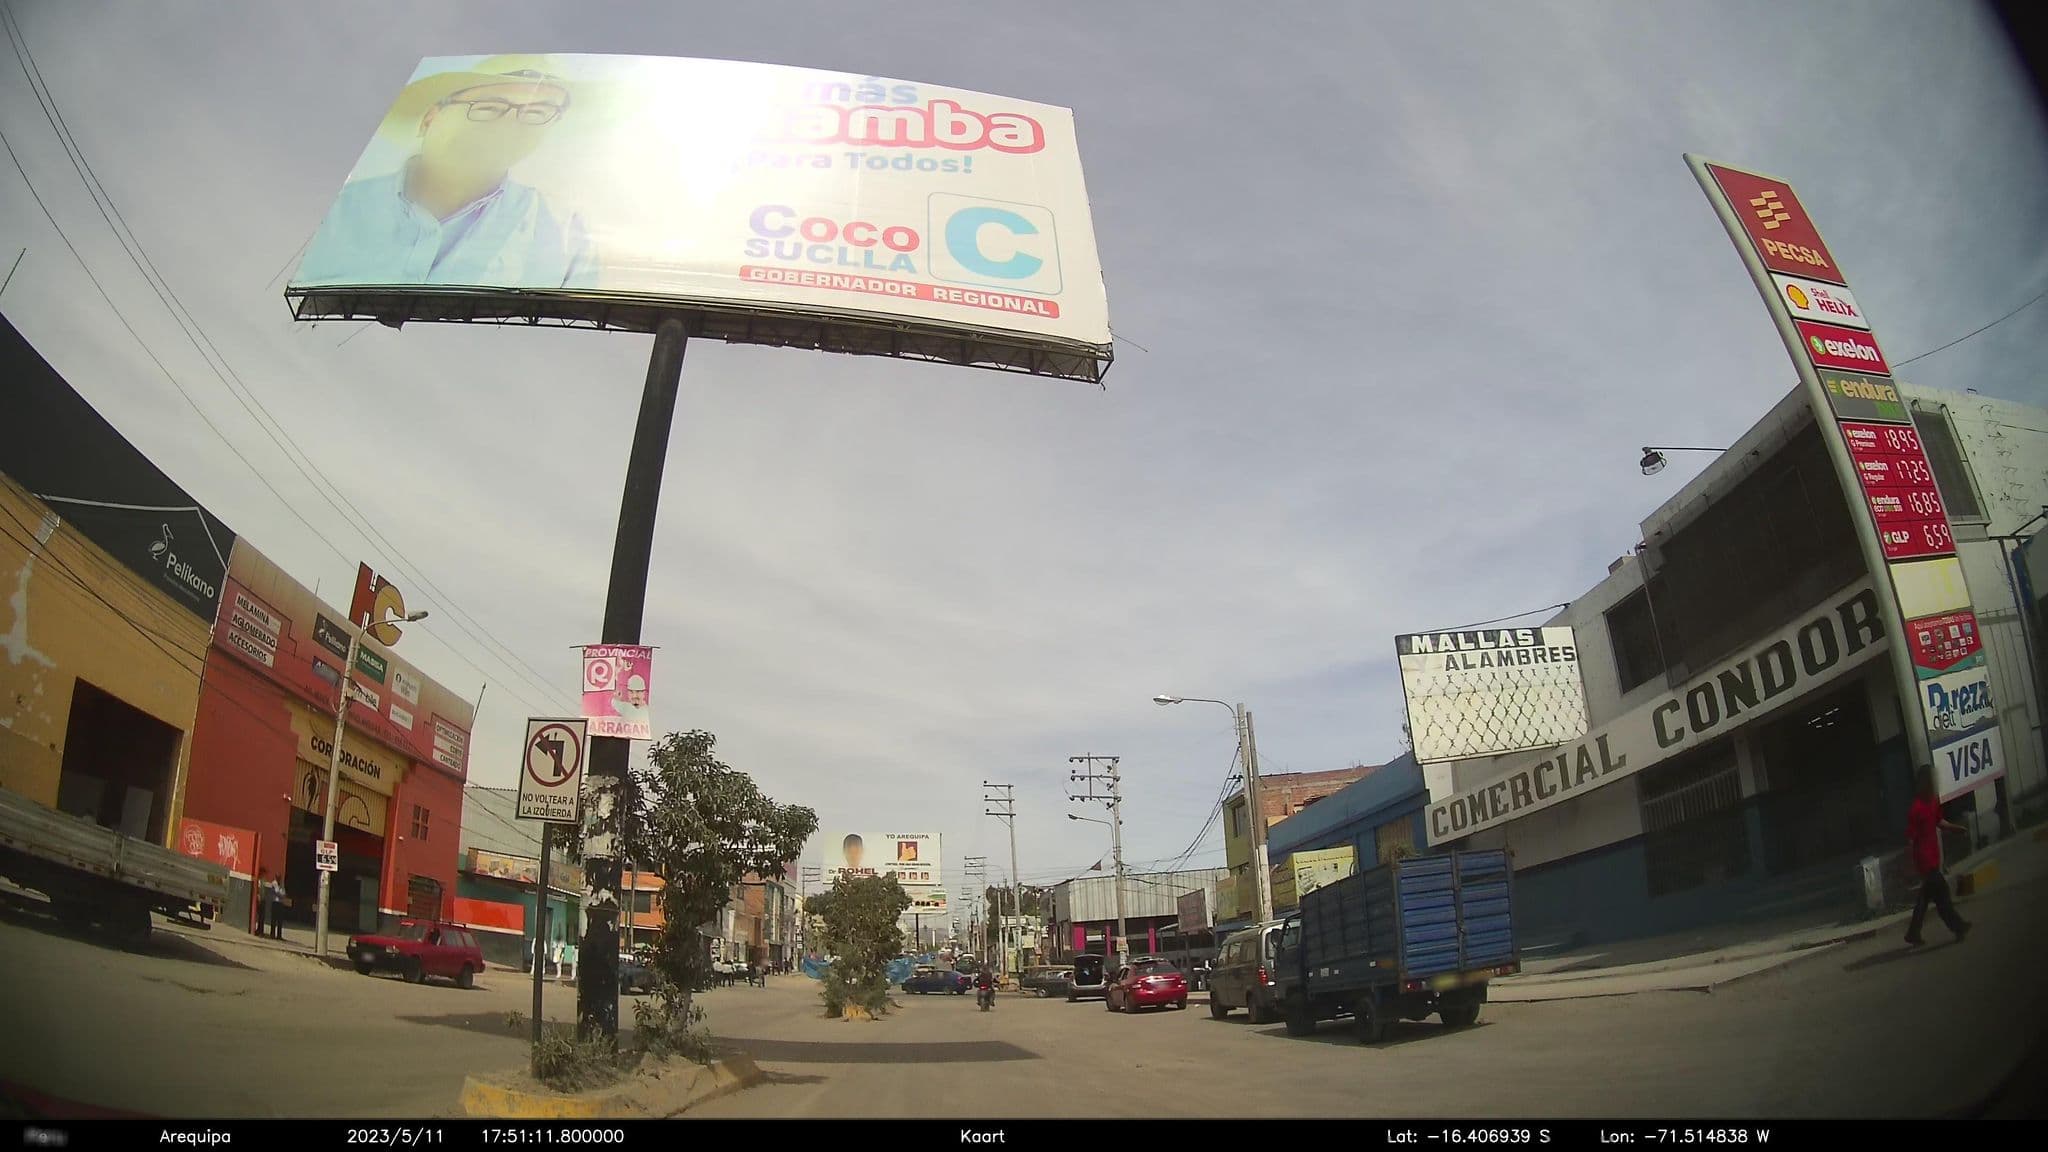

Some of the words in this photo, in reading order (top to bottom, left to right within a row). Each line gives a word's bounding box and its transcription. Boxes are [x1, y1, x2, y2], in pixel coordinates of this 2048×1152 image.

[845, 153, 973, 174] Todos!
[945, 206, 1044, 279] C
[1761, 237, 1830, 269] PECSA
[744, 238, 918, 274] SUCLLA
[750, 269, 917, 297] GOBERNADOR
[933, 287, 1050, 316] REGIONAL
[1811, 287, 1831, 299] Shell
[1814, 297, 1859, 318] HELIX
[1824, 338, 1880, 362] exelon
[1840, 378, 1898, 402] endura
[1883, 428, 1919, 453] 18.95
[1896, 460, 1930, 484] 17.25
[1907, 492, 1941, 516] 16.85
[1891, 530, 1910, 544] GLP
[1922, 523, 1952, 550] 6.59
[166, 551, 215, 599] Pelikano
[236, 595, 271, 627] MELAMINA
[228, 631, 269, 663] ACCESORIOS
[1411, 628, 1535, 653] MALLAS
[585, 648, 652, 660] PROVINCIAL
[1445, 646, 1577, 672] ALAMBRES
[1431, 733, 1627, 838] COMERCIAL
[1651, 588, 1887, 749] CONDOR
[589, 721, 649, 736] ARRAGAN
[311, 735, 381, 780] CORORACIÓN
[1946, 737, 1994, 782] VISA
[522, 793, 534, 802] NO
[535, 794, 569, 806] VOLTEAR
[568, 797, 574, 805] A
[522, 805, 532, 815] LA
[533, 806, 572, 819] IZQUIERDA
